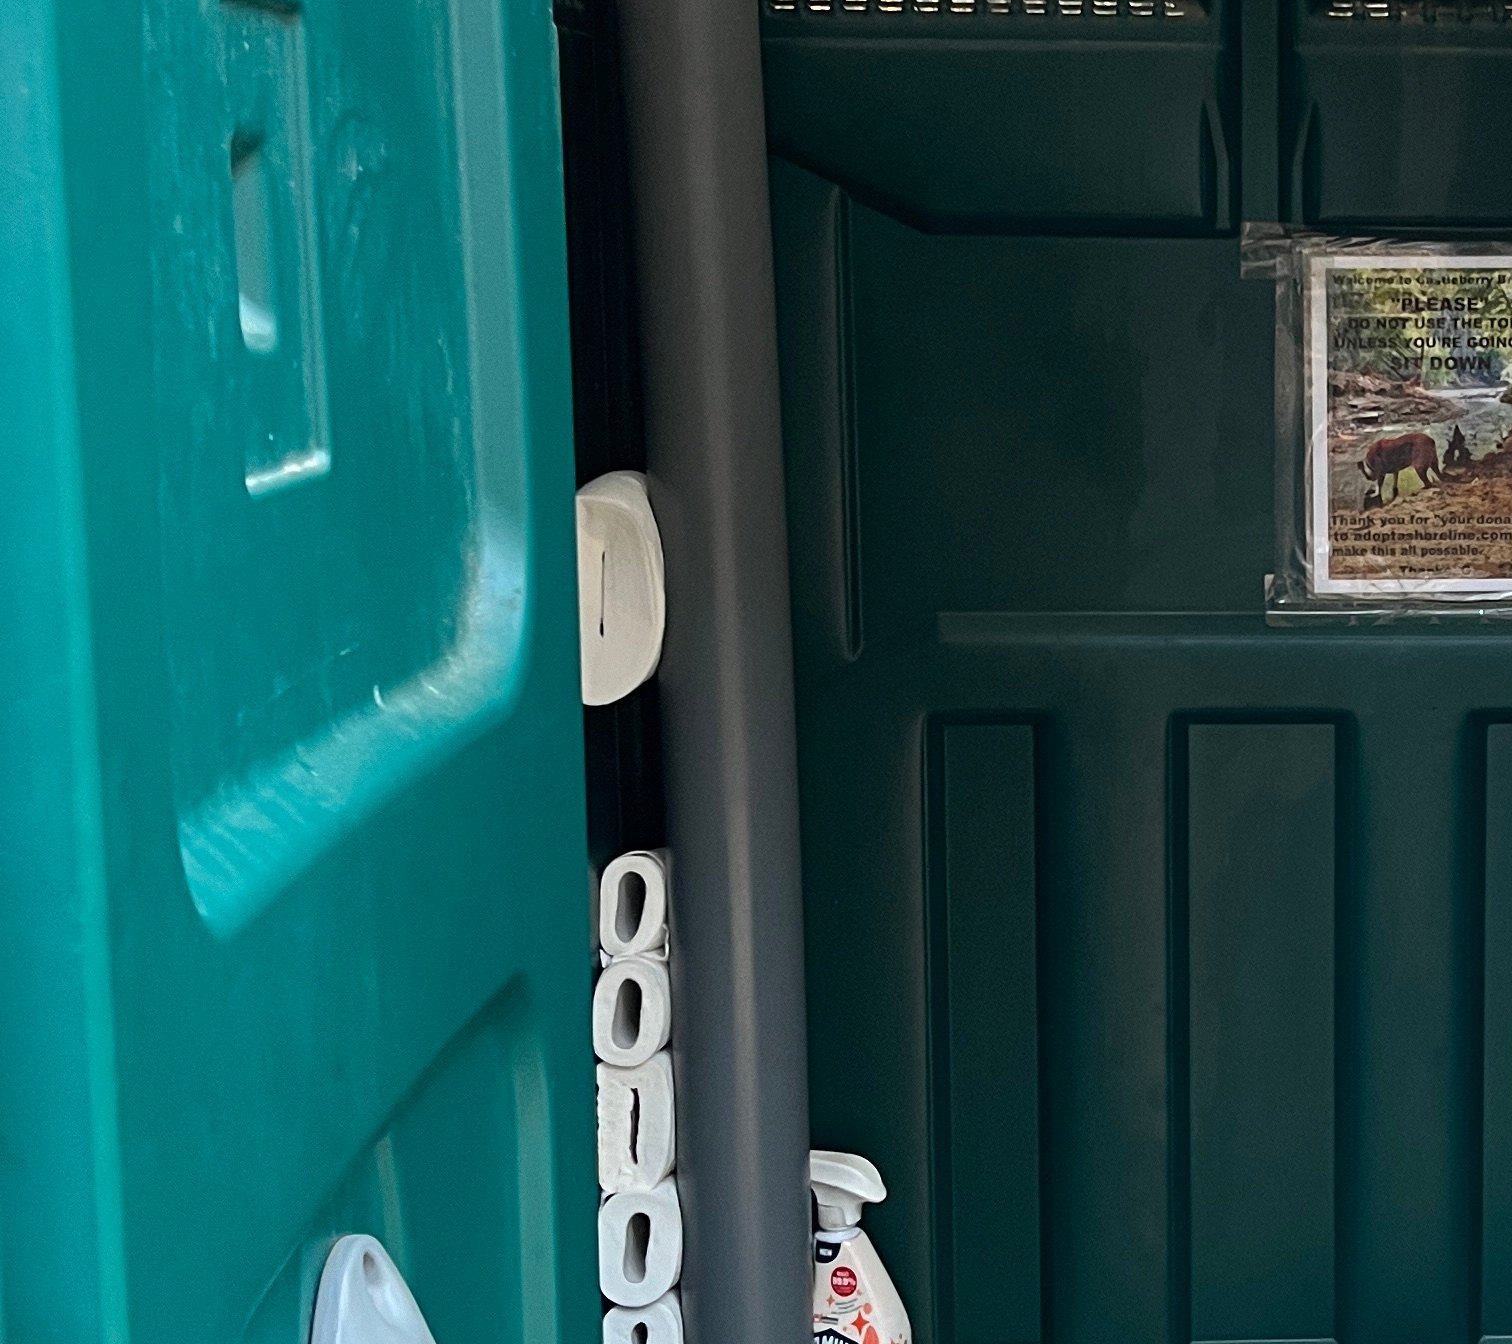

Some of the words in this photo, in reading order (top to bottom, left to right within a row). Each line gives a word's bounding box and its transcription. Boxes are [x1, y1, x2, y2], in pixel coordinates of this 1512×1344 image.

[1400, 274, 1412, 286] to
[1392, 297, 1488, 312] "PLEASE"
[1349, 317, 1370, 330] DO
[1376, 317, 1409, 330] NOT
[1414, 317, 1446, 330] USE
[1450, 317, 1482, 330] THE
[1334, 336, 1397, 349] UNLESS
[1403, 336, 1462, 349] YOU'RE
[1391, 356, 1424, 371] SIT
[1429, 356, 1492, 371] DOWN
[1331, 515, 1375, 526] Thank
[1379, 516, 1406, 528] you
[1410, 514, 1430, 526] for
[1333, 531, 1349, 542] to
[1353, 530, 1512, 544] adoptashoreline.com
[1331, 546, 1368, 557] make
[1372, 546, 1396, 557] this
[1400, 546, 1418, 556] all
